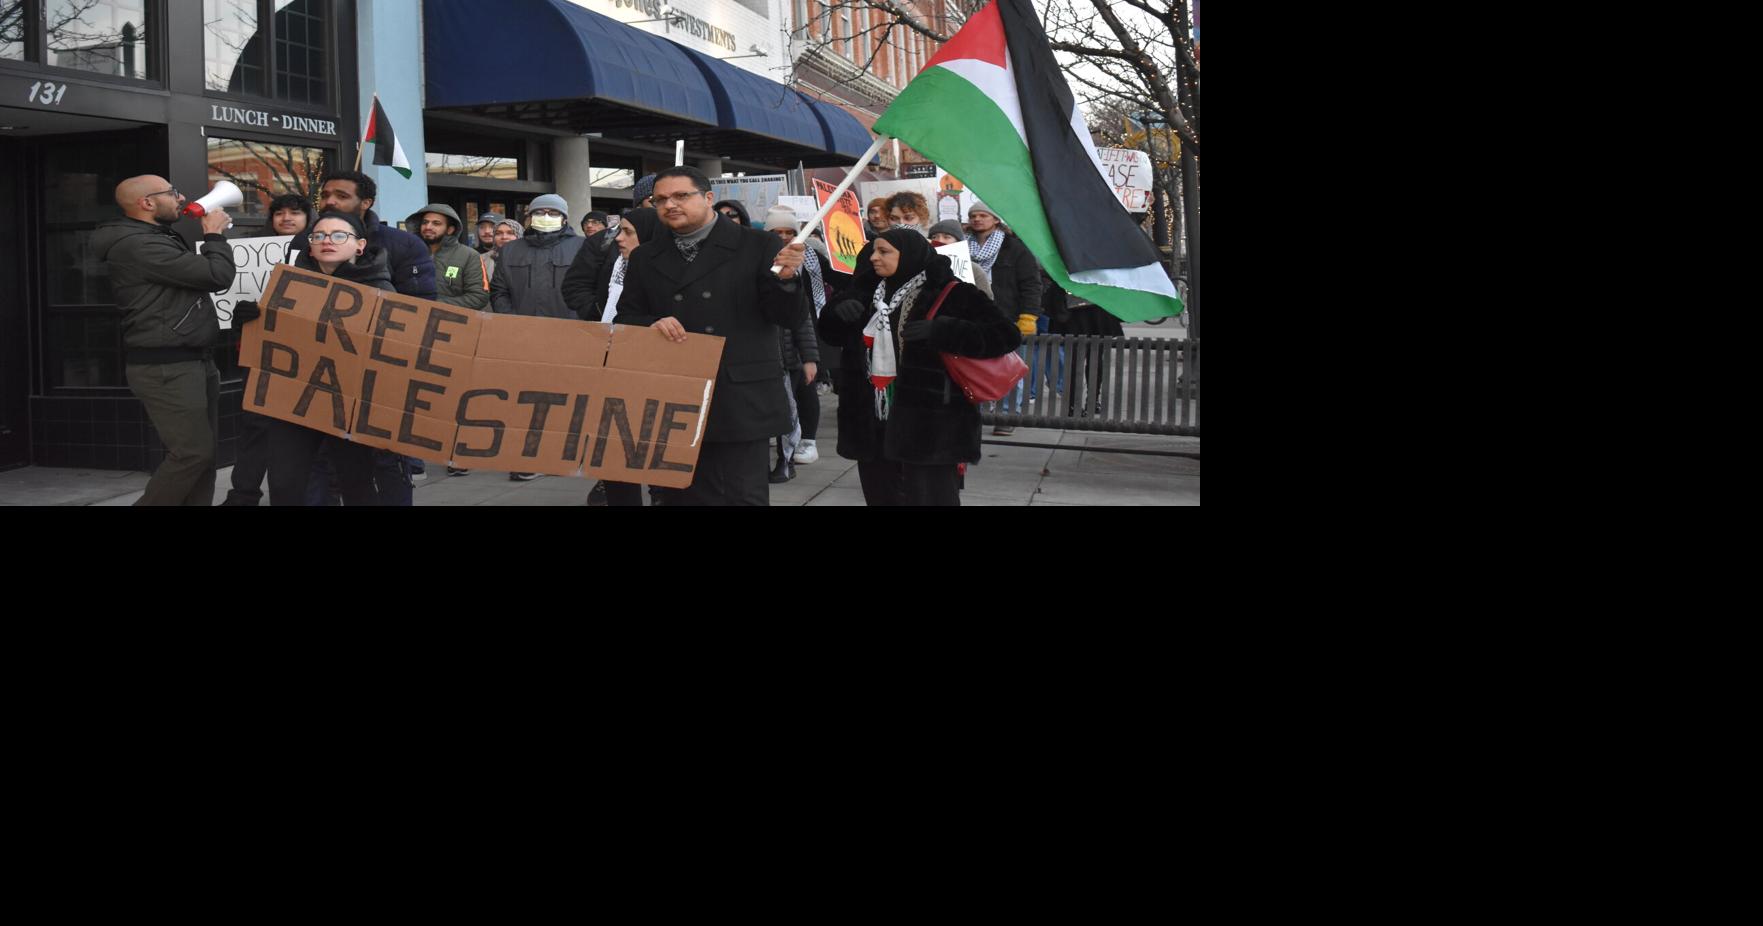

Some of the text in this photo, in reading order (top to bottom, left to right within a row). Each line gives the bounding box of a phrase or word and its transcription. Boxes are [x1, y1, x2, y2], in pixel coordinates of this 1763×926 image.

[29, 81, 67, 105] 131
[211, 104, 269, 127] LUNCH
[281, 114, 336, 135] DINNER
[264, 270, 469, 377] FREE
[254, 340, 700, 473] PALESTINE
